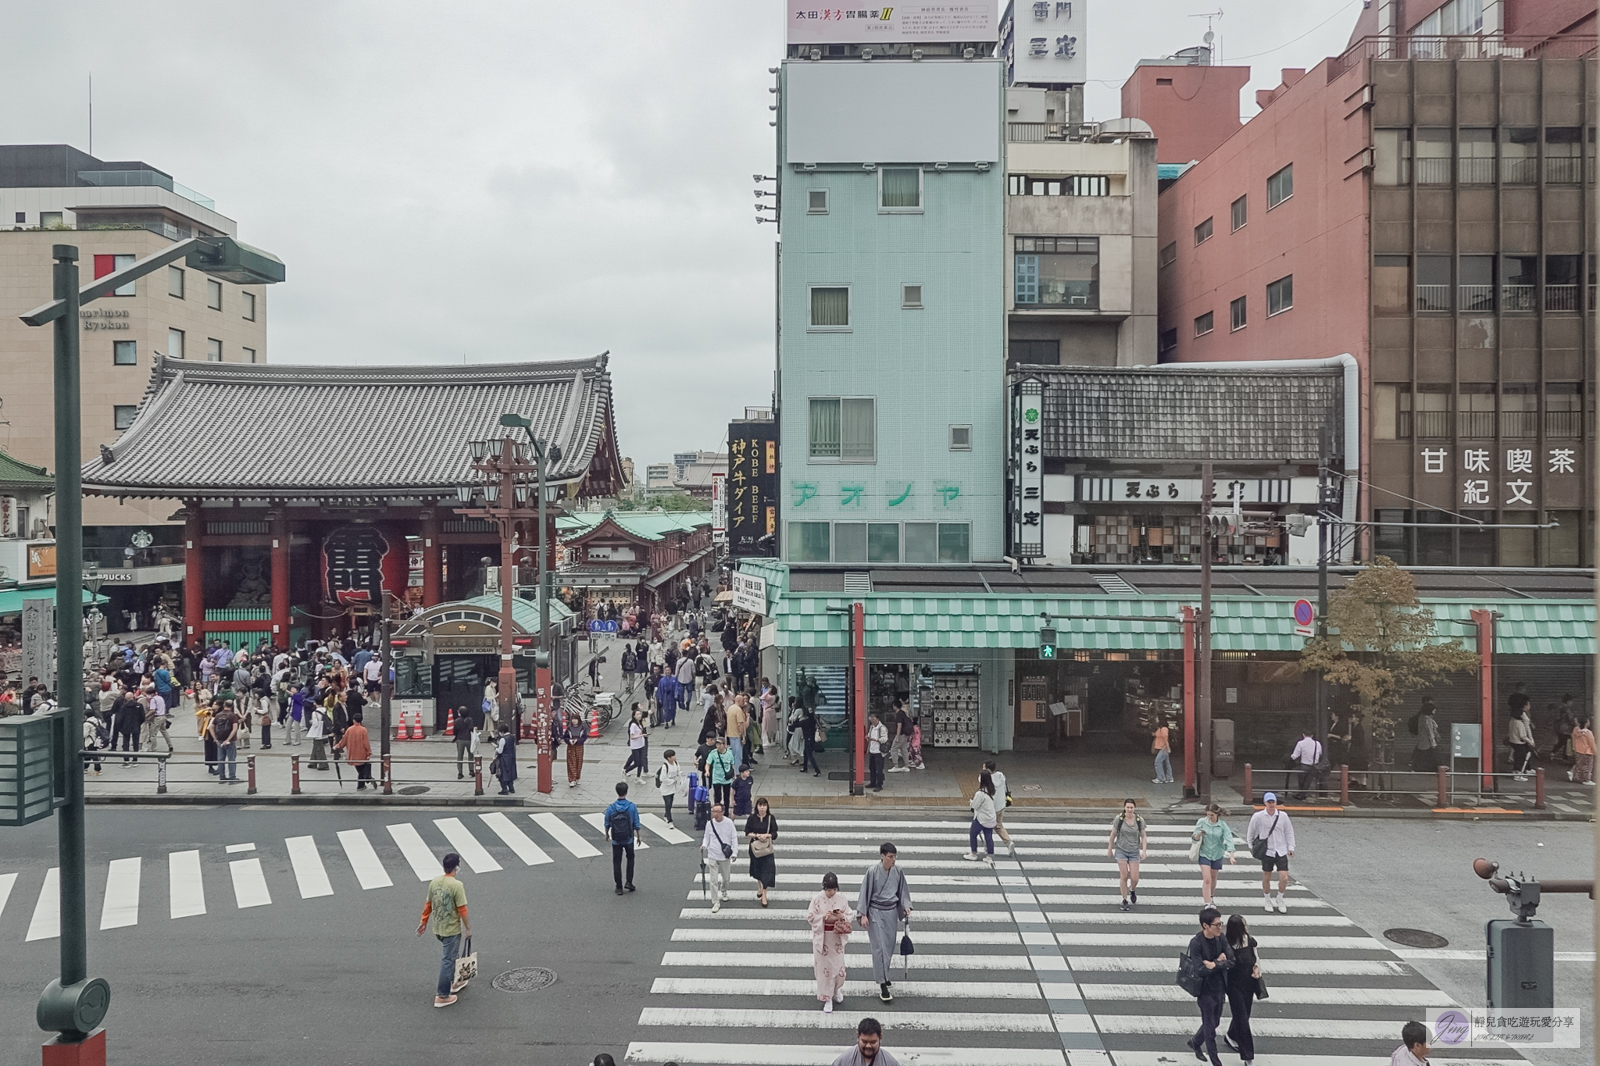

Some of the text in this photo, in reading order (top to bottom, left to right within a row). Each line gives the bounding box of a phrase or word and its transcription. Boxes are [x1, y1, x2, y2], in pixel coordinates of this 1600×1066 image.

[1028, 34, 1077, 58] 三定
[84, 320, 129, 331] Ryokan
[1420, 447, 1576, 474] 甘味喫茶
[732, 438, 748, 529] 神戸牛ダイア
[751, 439, 759, 524] KOBE BEEF
[793, 483, 960, 507] アオノヤ
[1463, 478, 1533, 505] 紀文
